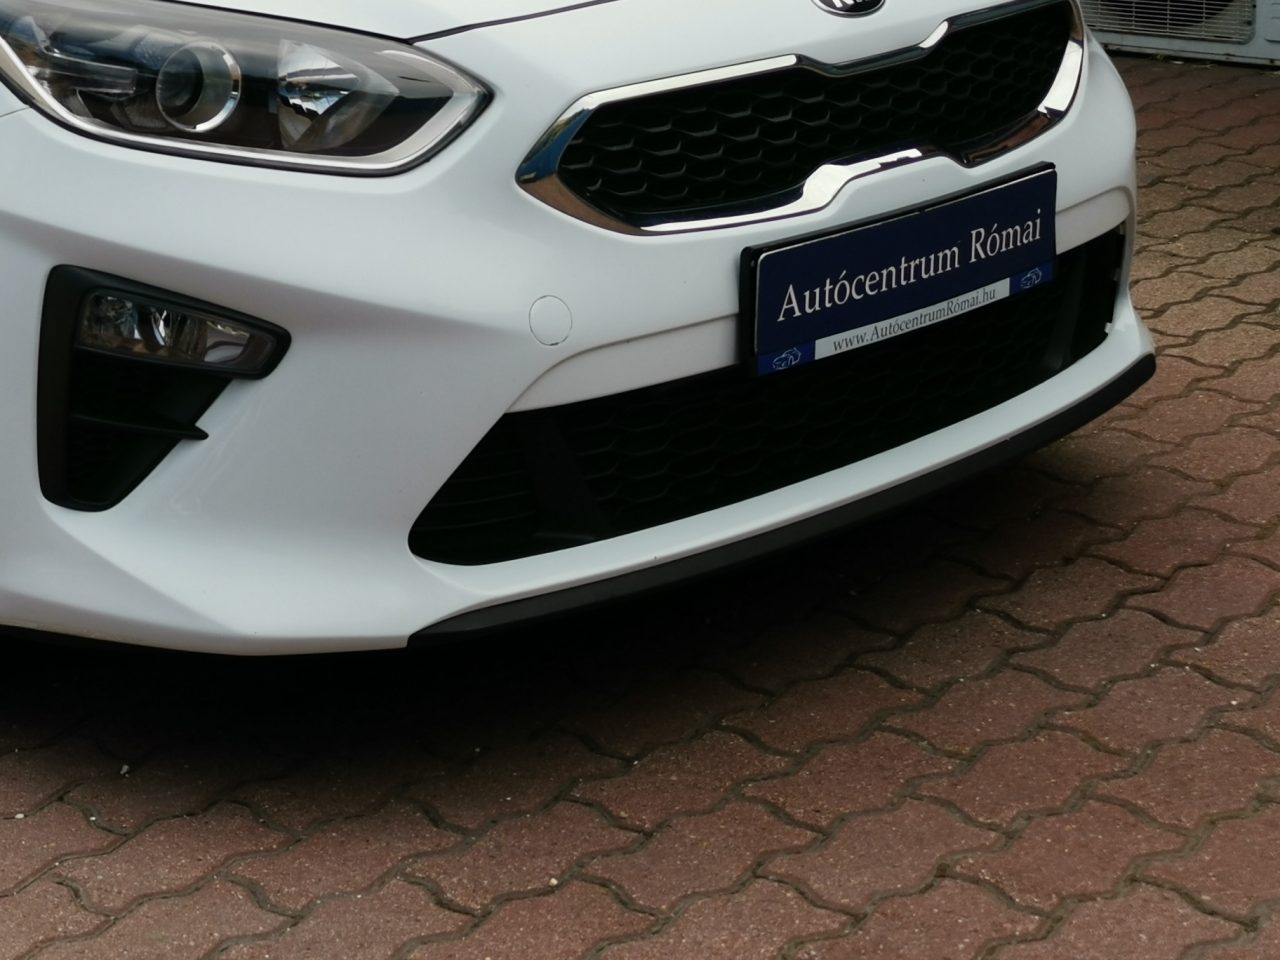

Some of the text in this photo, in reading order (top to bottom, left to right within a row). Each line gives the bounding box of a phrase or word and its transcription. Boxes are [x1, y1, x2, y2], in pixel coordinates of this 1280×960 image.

[777, 209, 1041, 322] Autócentrum Római
[833, 287, 996, 352] www.AutócentrumRómai.hu
